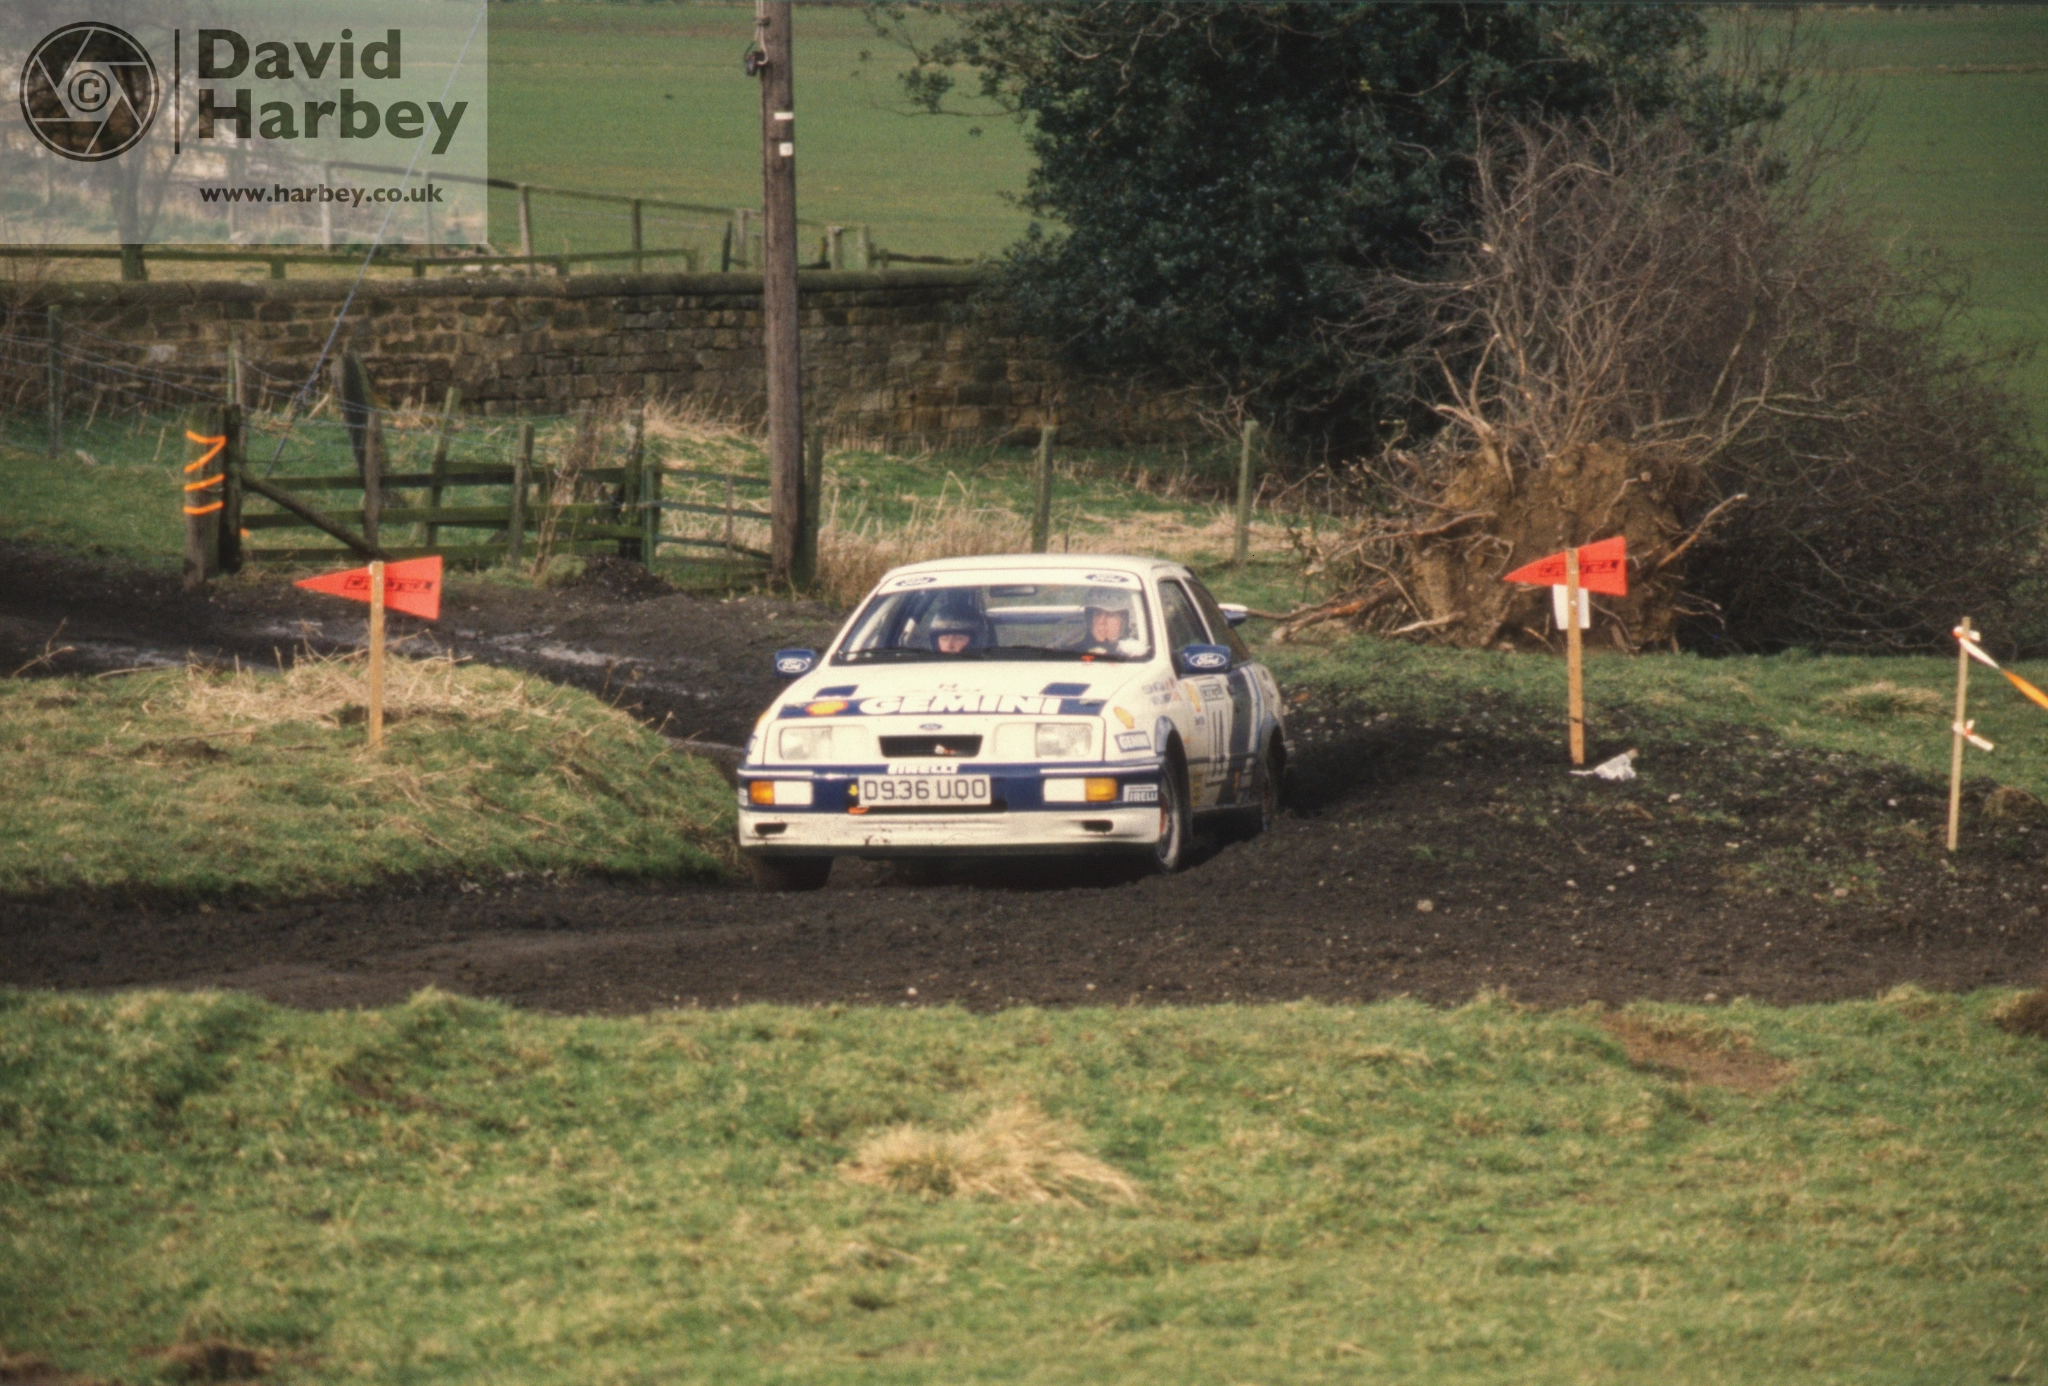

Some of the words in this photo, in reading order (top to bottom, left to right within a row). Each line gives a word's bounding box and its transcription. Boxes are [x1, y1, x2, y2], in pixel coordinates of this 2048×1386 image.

[1194, 653, 1222, 666] Ford
[859, 695, 1061, 715] GEMINI
[864, 780, 929, 800] D936
